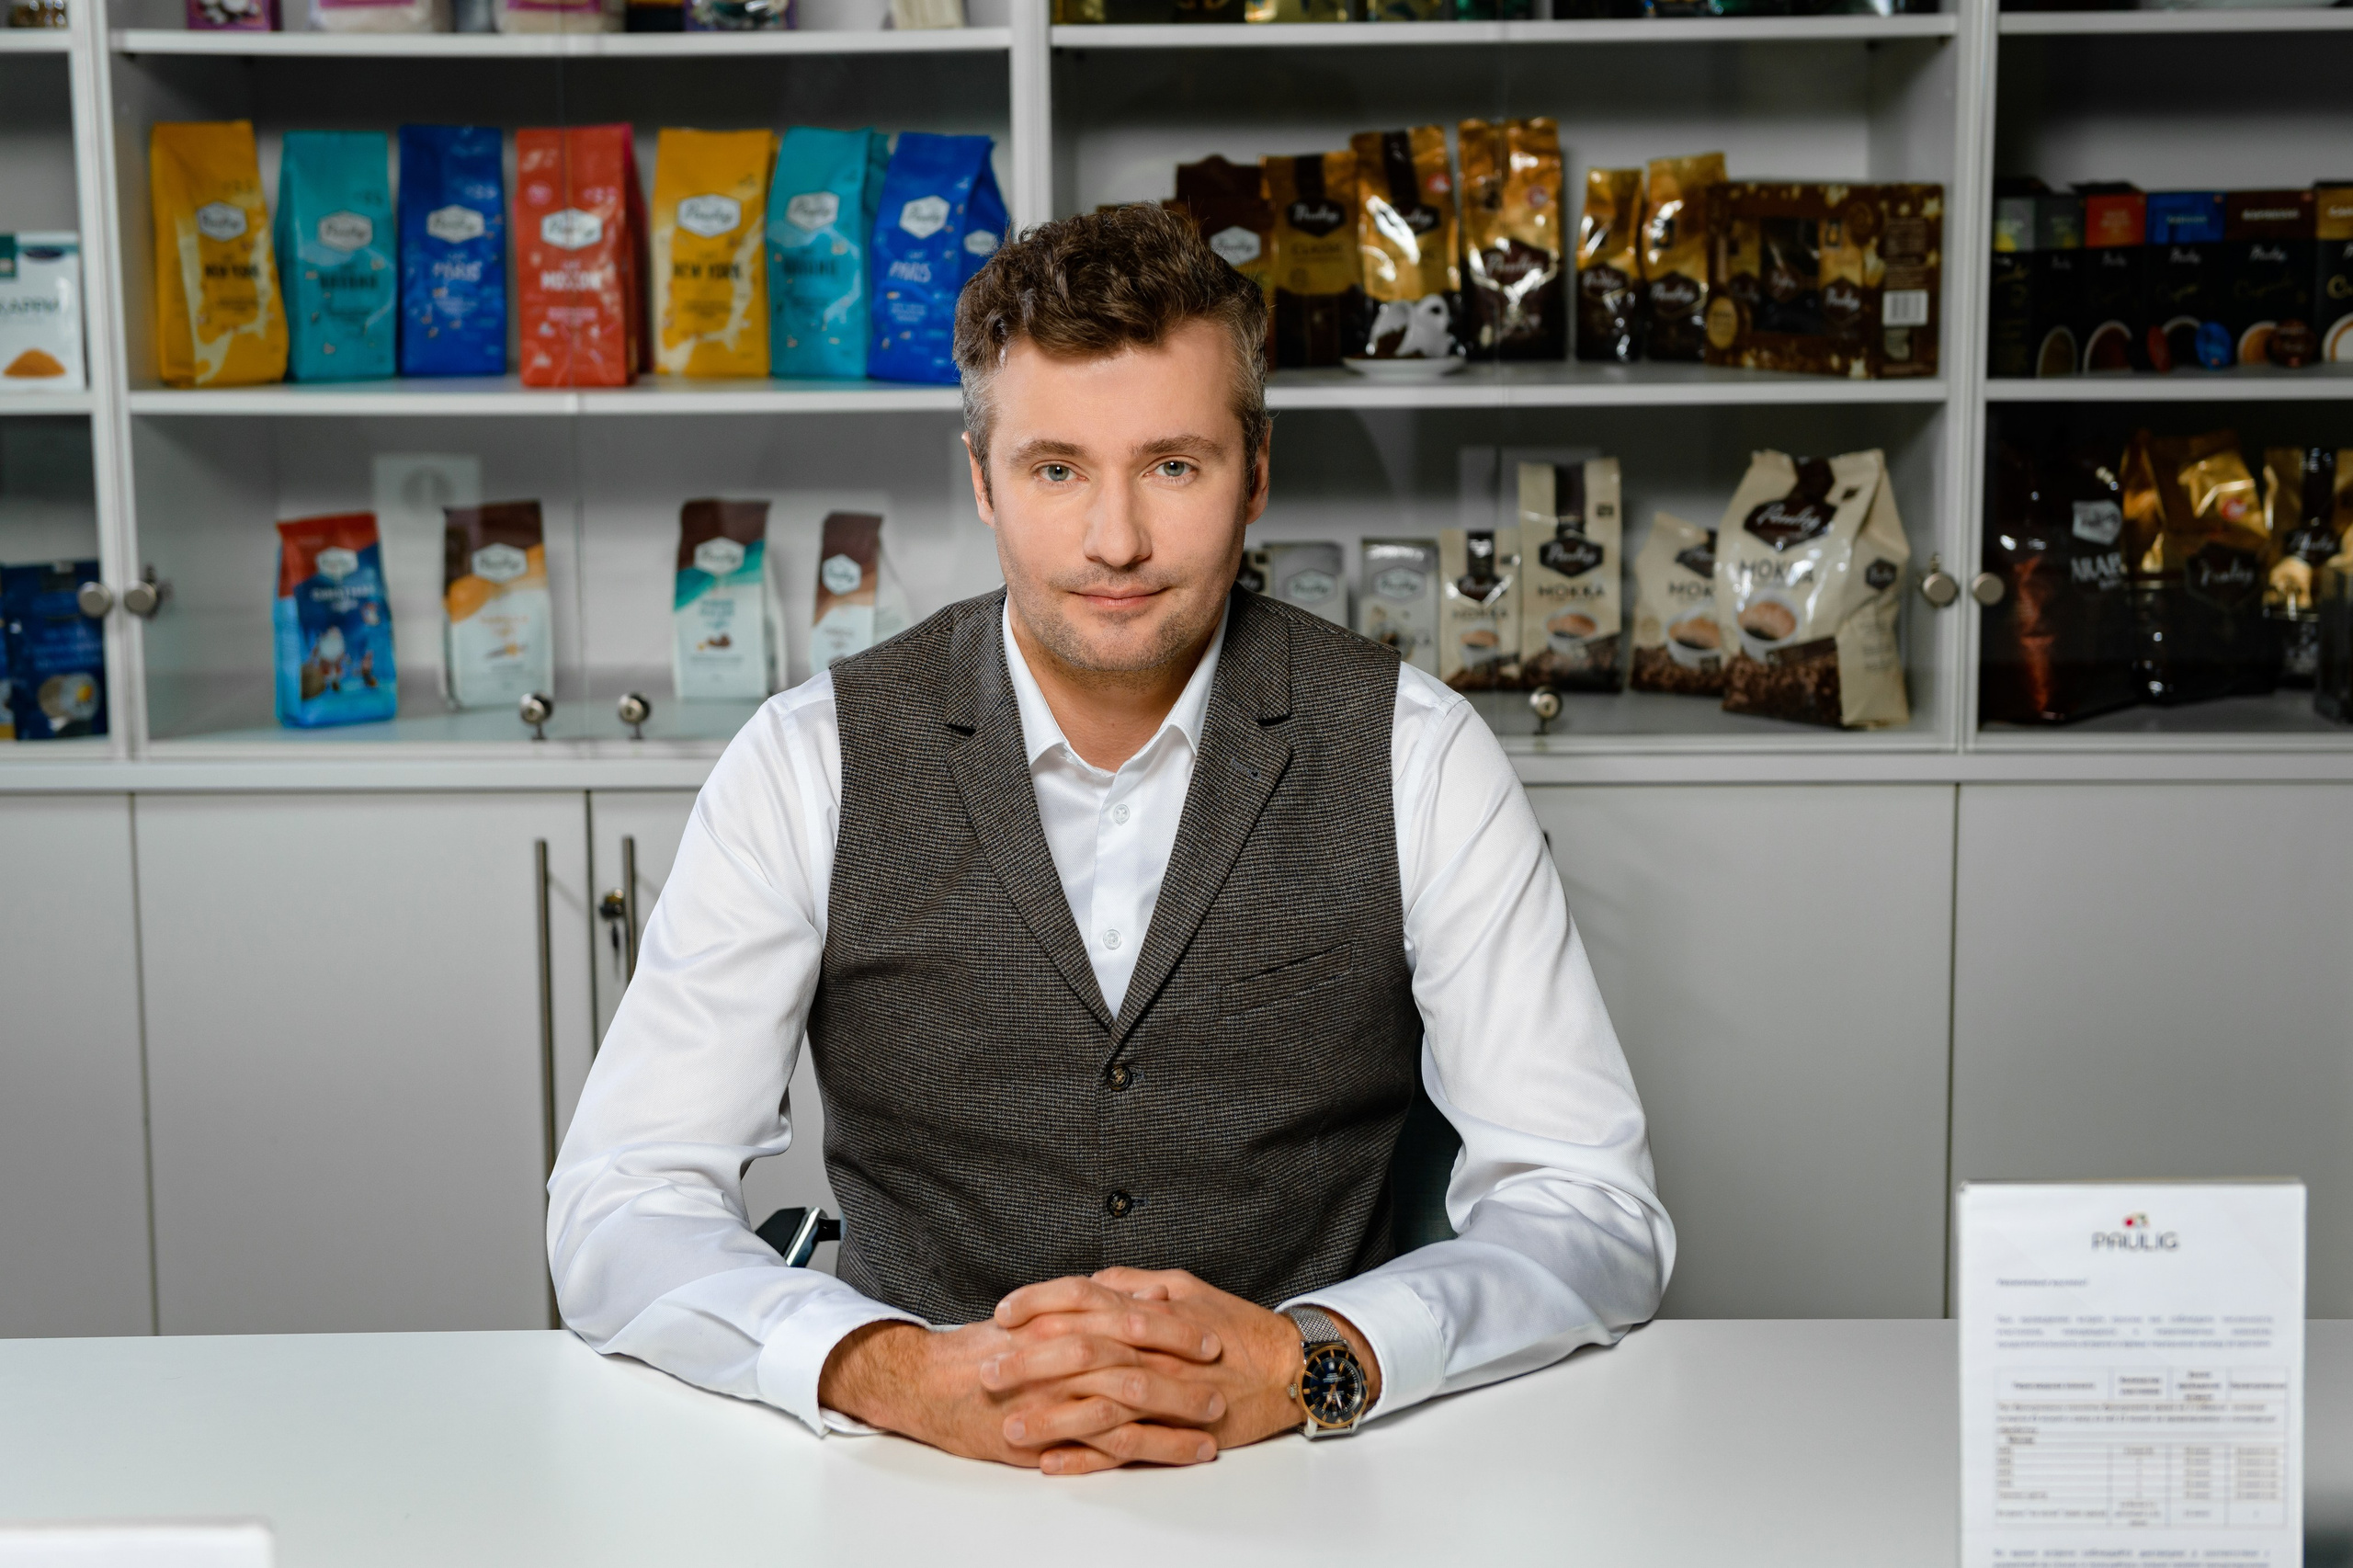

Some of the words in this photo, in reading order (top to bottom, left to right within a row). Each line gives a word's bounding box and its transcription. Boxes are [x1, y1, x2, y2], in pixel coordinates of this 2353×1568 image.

[1293, 202, 1340, 223] Paulig
[888, 261, 932, 283] PARIS
[1756, 505, 1823, 533] Paulig
[1739, 559, 1814, 584] MOKA
[1537, 584, 1605, 598] MOKKA
[2091, 1231, 2179, 1252] PAULIG
